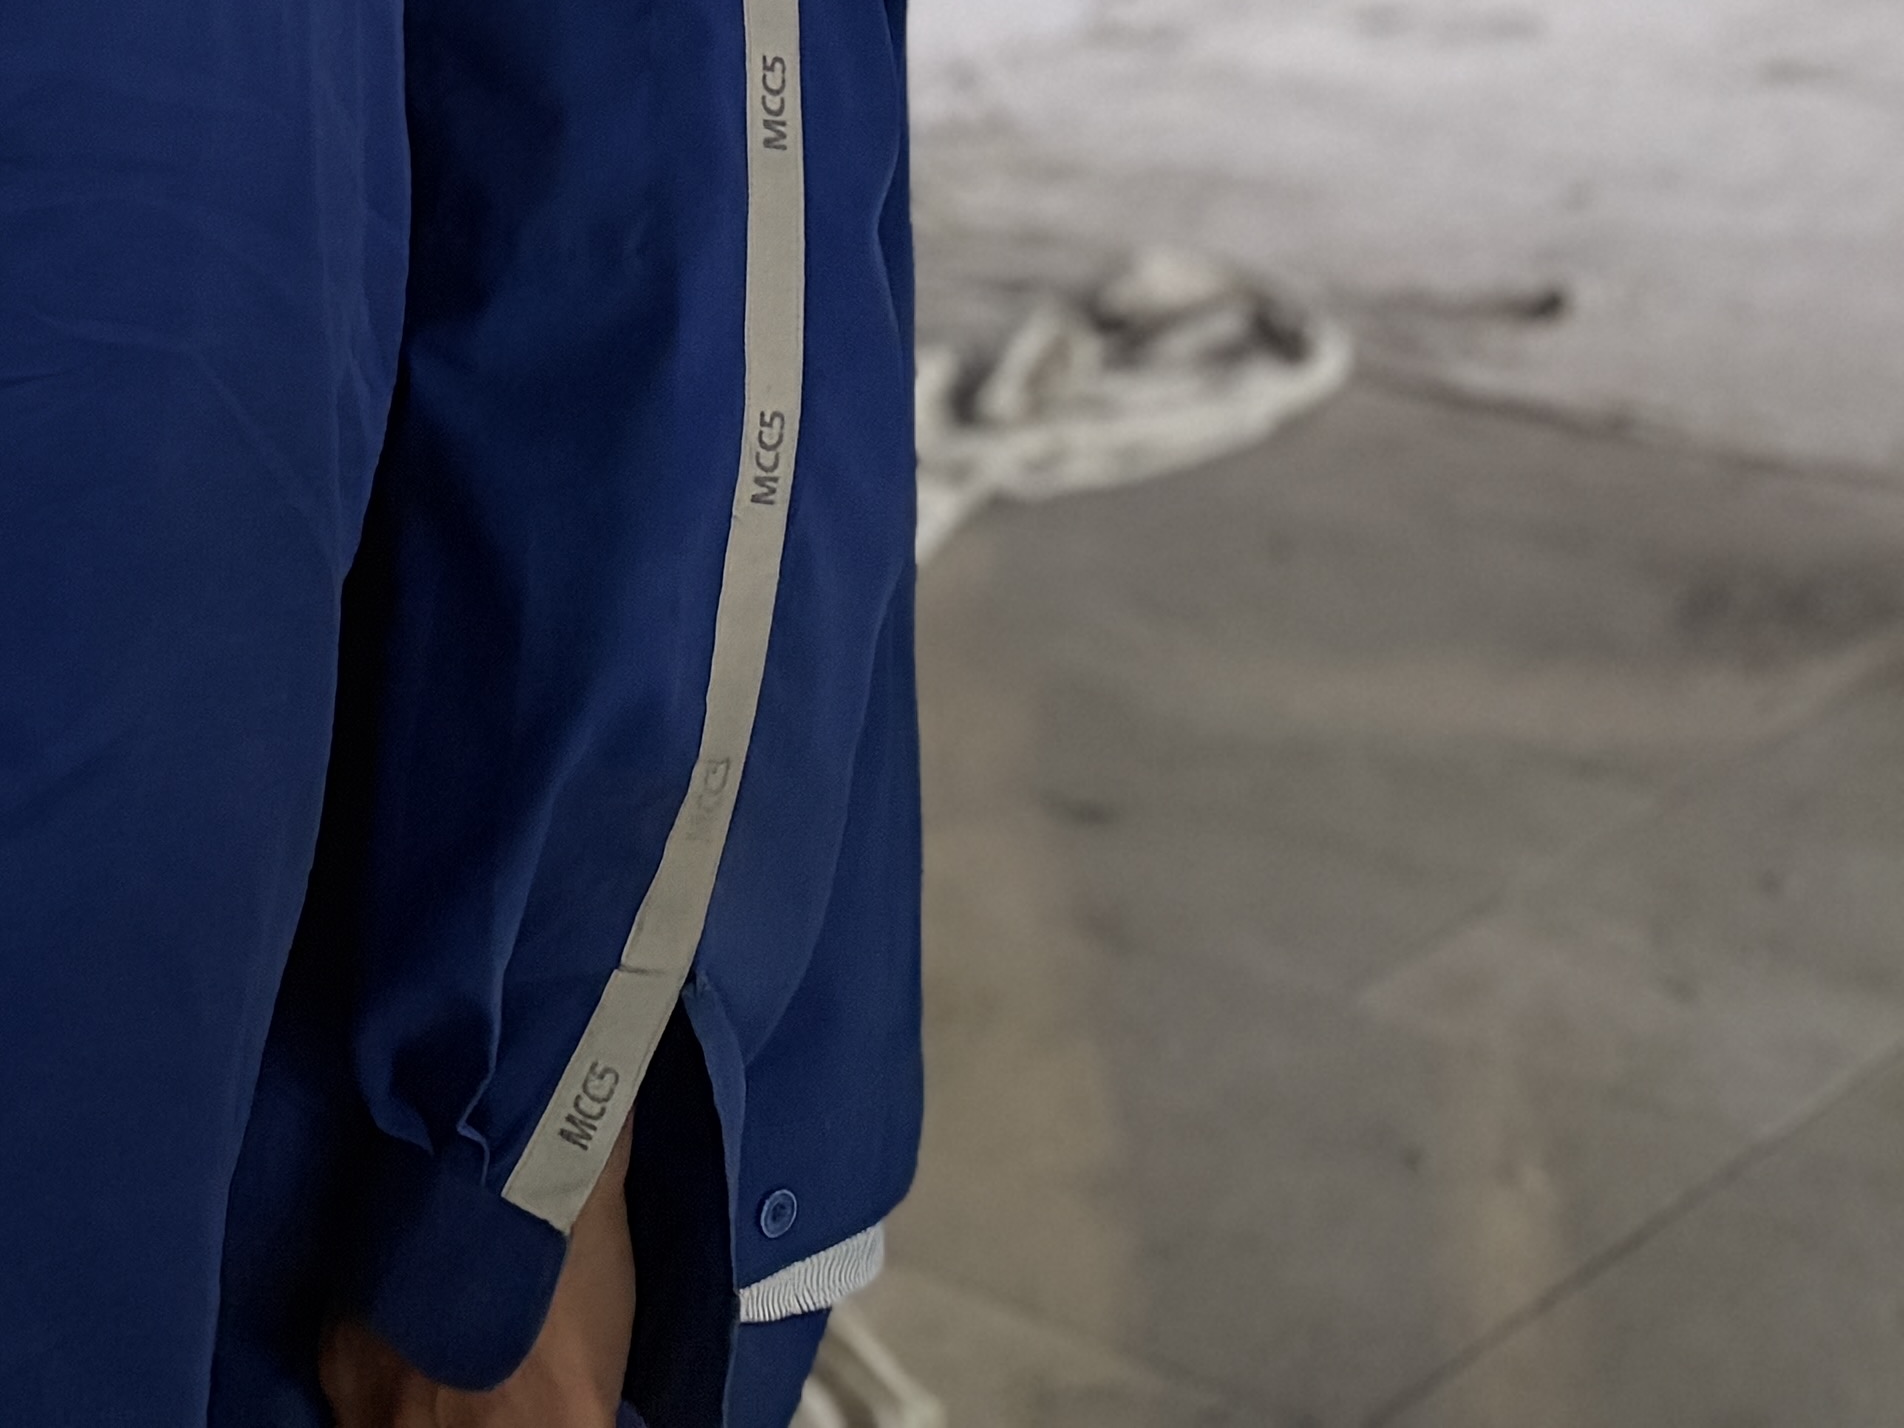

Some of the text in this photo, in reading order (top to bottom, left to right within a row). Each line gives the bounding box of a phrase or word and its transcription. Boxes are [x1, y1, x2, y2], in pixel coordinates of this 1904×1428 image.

[761, 54, 788, 152] MCC5
[750, 410, 786, 505] MCC5
[685, 756, 731, 842] CC5
[557, 1059, 620, 1151] MCC5
